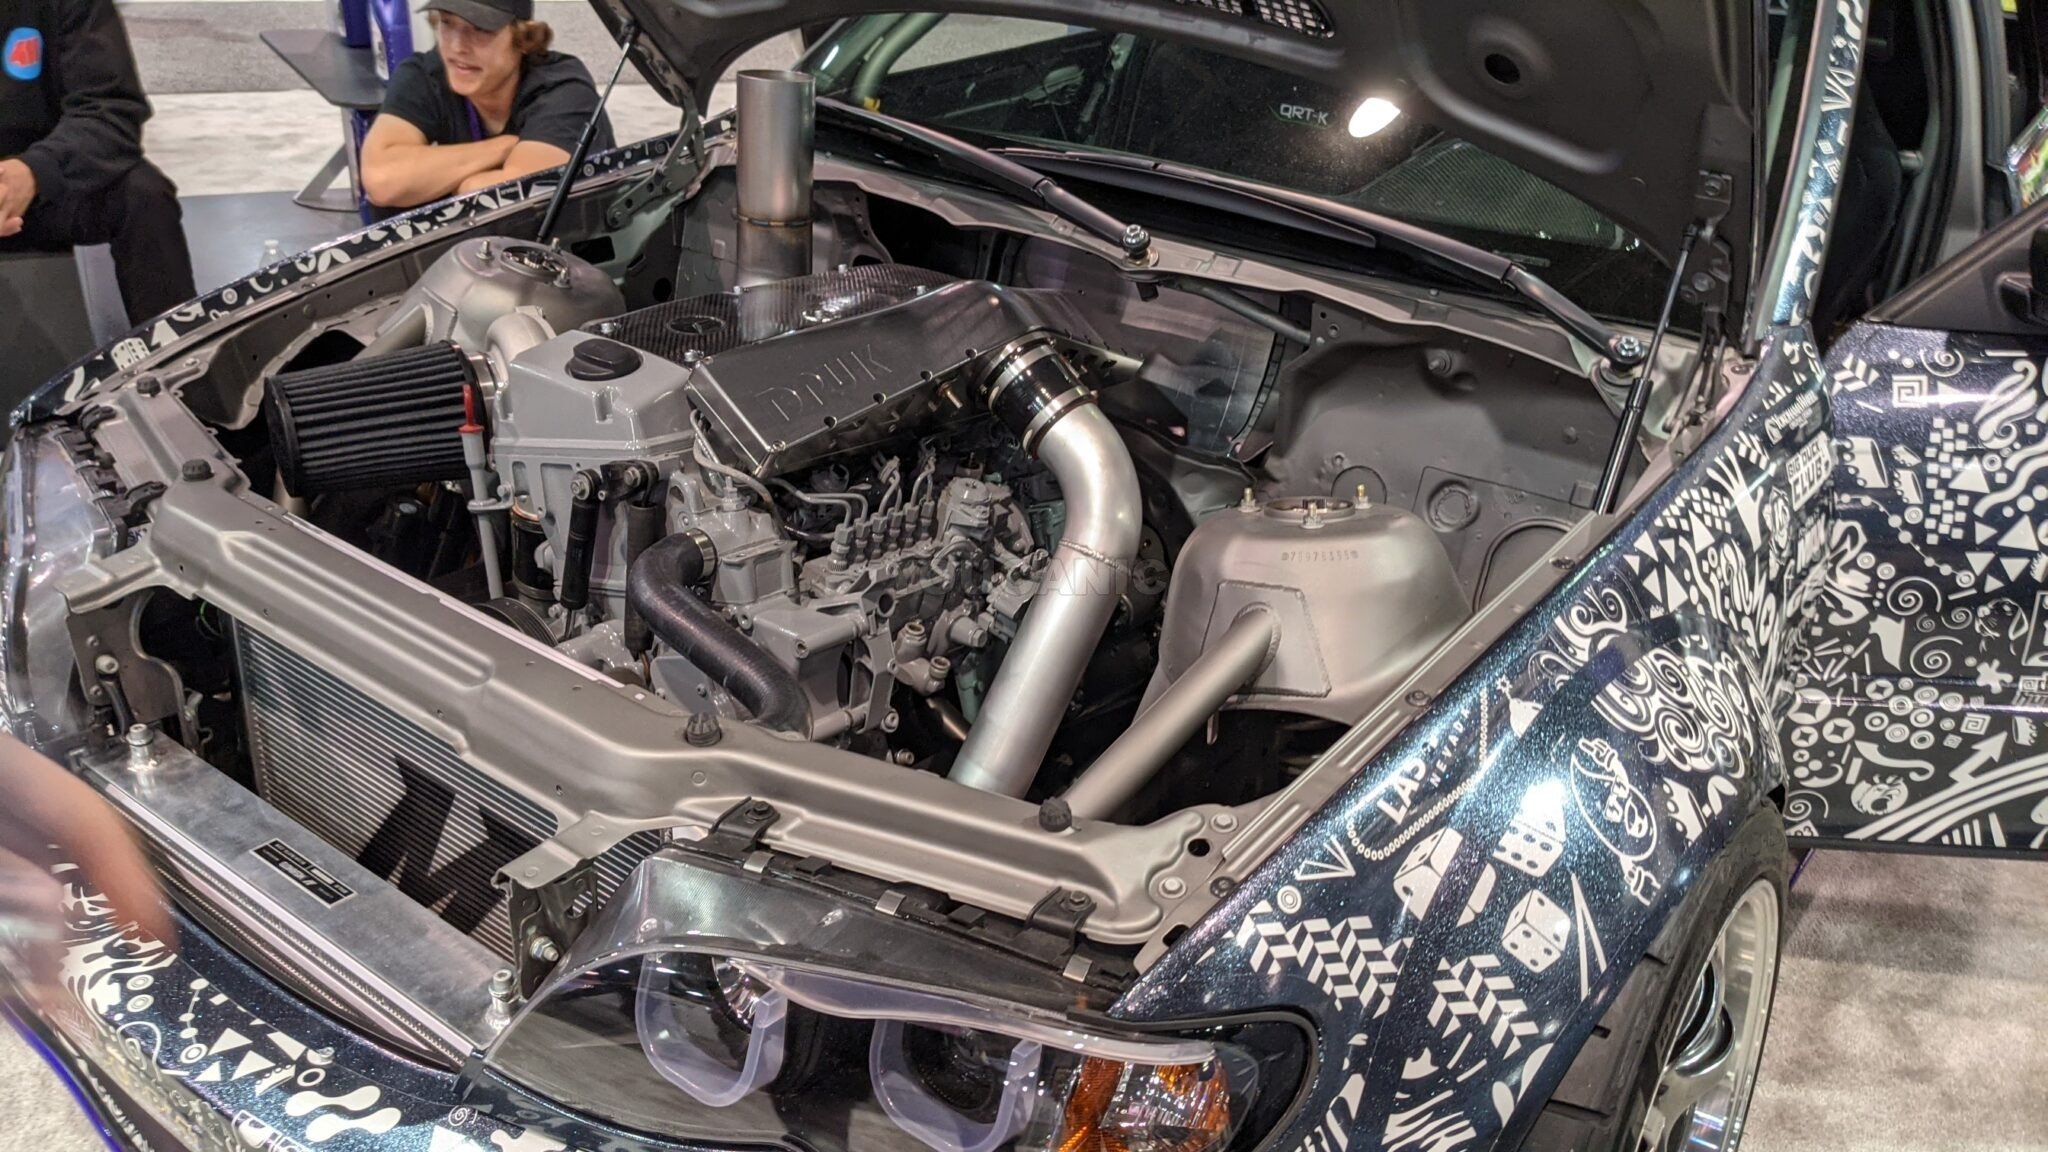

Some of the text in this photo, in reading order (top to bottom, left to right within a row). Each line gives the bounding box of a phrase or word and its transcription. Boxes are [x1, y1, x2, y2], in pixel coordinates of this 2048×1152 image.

[1280, 103, 1329, 125] QRT-K
[1787, 456, 1801, 478] BIG
[1792, 456, 1822, 503] CLUB
[1429, 708, 1471, 788] NEVADA
